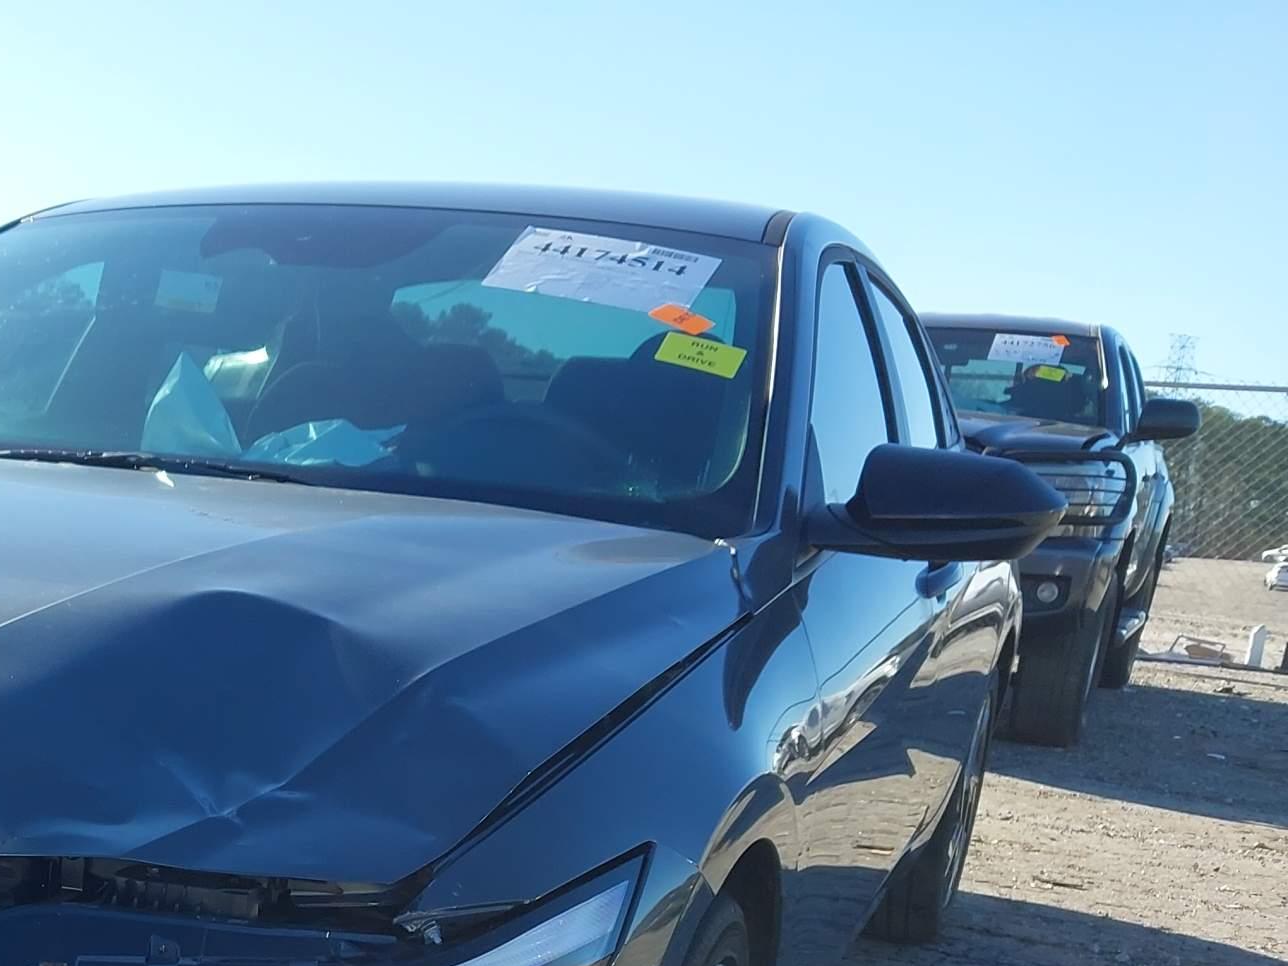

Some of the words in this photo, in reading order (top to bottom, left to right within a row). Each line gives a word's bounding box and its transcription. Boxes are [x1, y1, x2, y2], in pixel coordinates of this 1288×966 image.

[533, 242, 687, 276] 44174514
[691, 341, 719, 353] RUN
[678, 353, 716, 367] DRIVE
